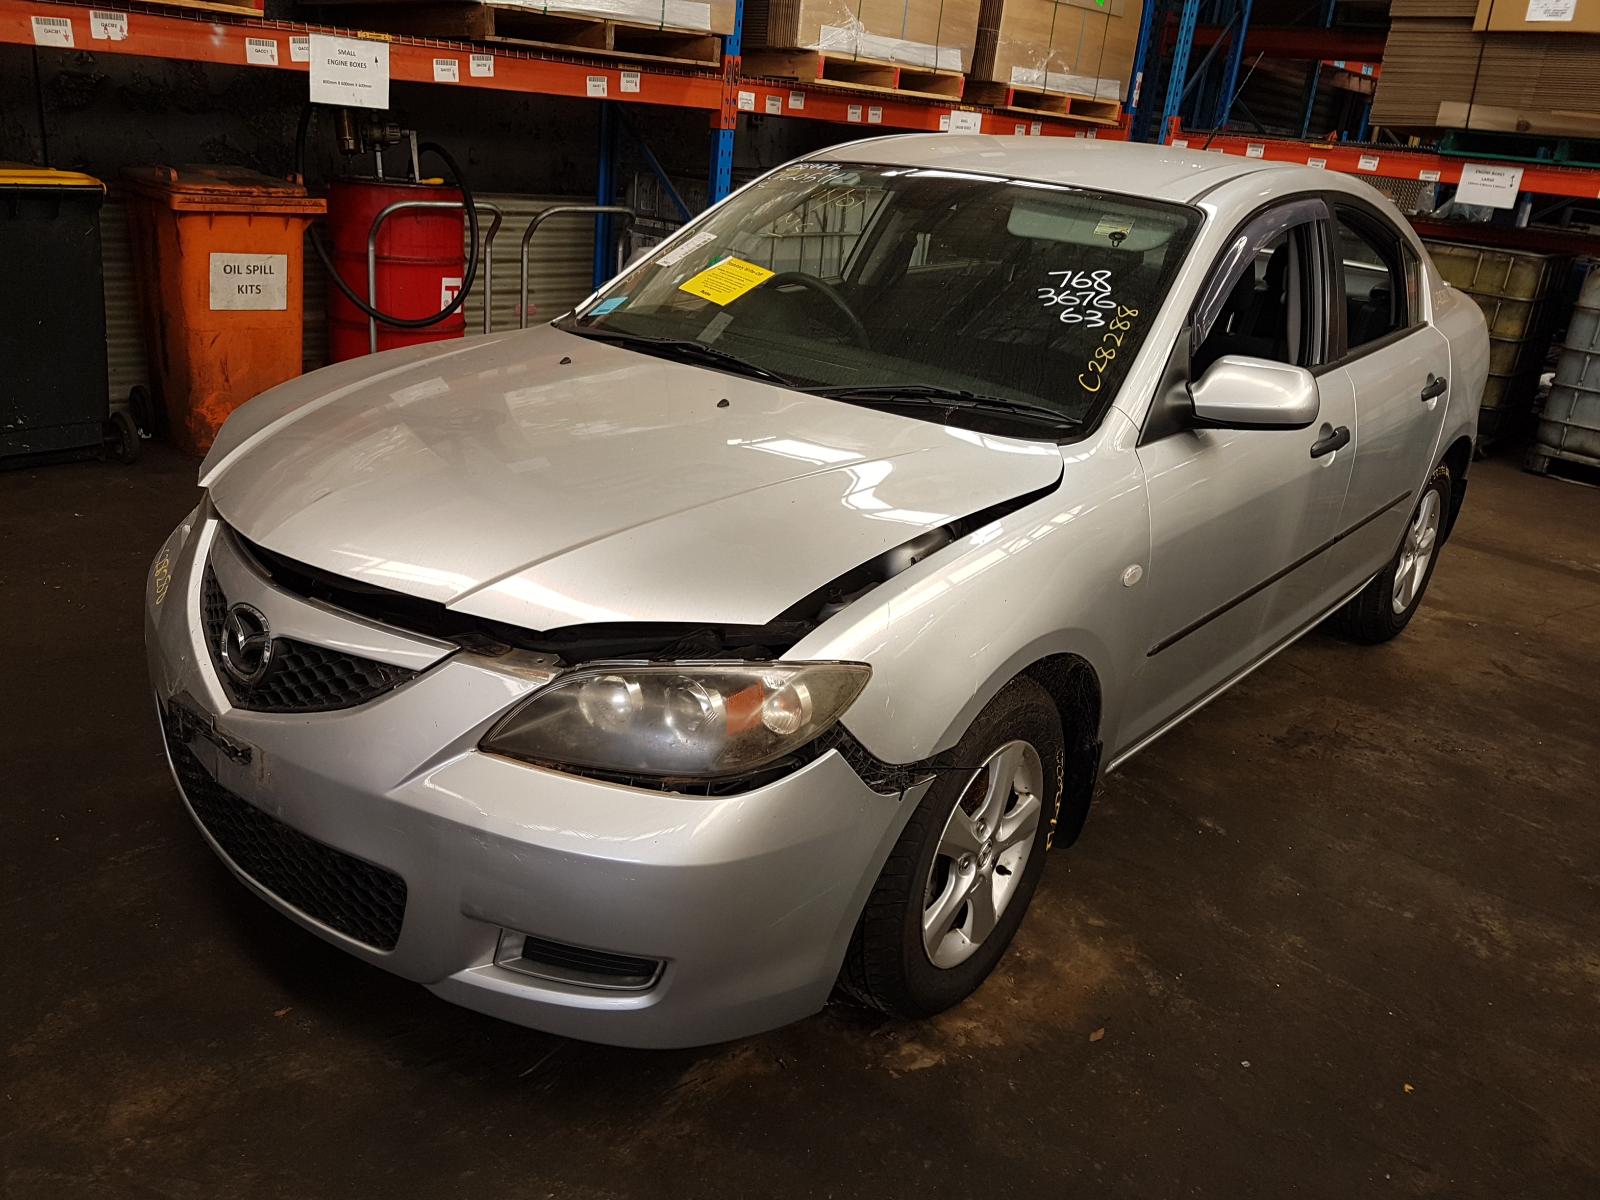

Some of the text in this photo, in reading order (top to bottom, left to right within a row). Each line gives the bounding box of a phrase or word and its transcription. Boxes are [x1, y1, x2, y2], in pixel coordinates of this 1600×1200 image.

[337, 48, 356, 57] SMALL
[327, 58, 367, 69] ENGINE BOXES
[223, 264, 275, 275] OIL SPILL
[1048, 270, 1112, 292] 768
[237, 284, 262, 294] KITS
[1037, 288, 1117, 309] 3676
[1059, 308, 1105, 328] 63
[1078, 305, 1139, 392] C28288
